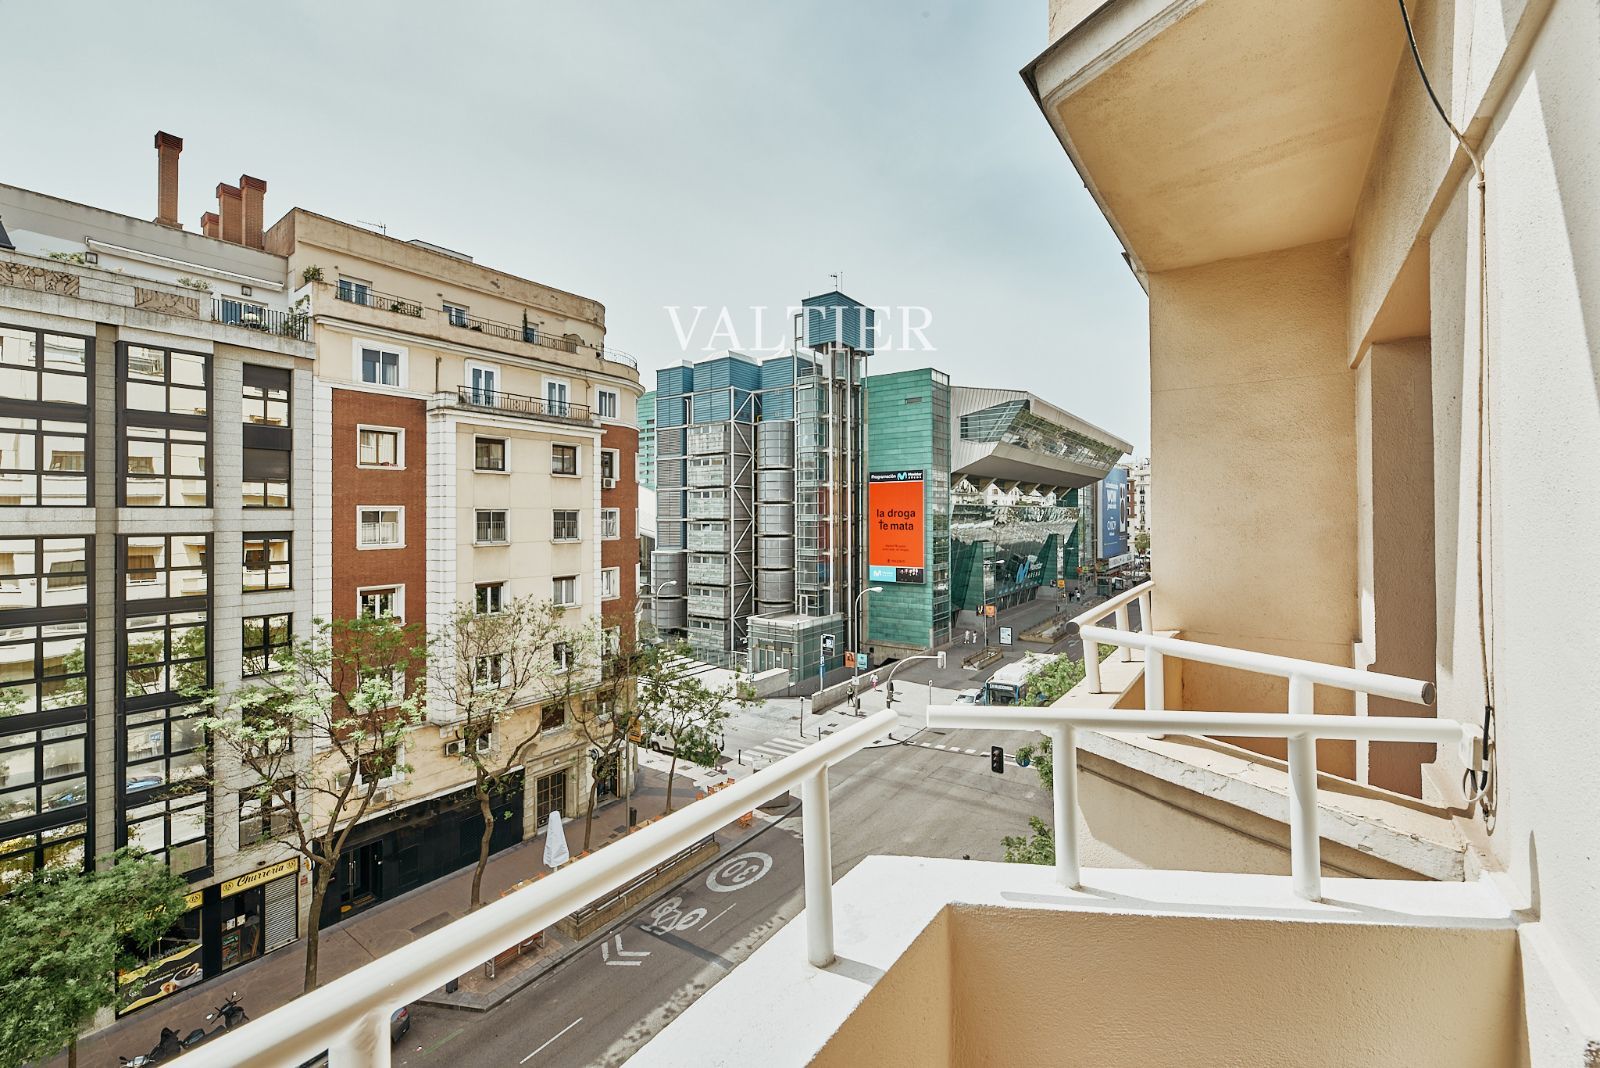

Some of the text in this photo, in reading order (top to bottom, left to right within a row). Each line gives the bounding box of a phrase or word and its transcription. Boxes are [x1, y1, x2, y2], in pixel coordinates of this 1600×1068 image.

[876, 509, 916, 520] la droga
[879, 519, 914, 531] te mata
[721, 860, 760, 883] 30
